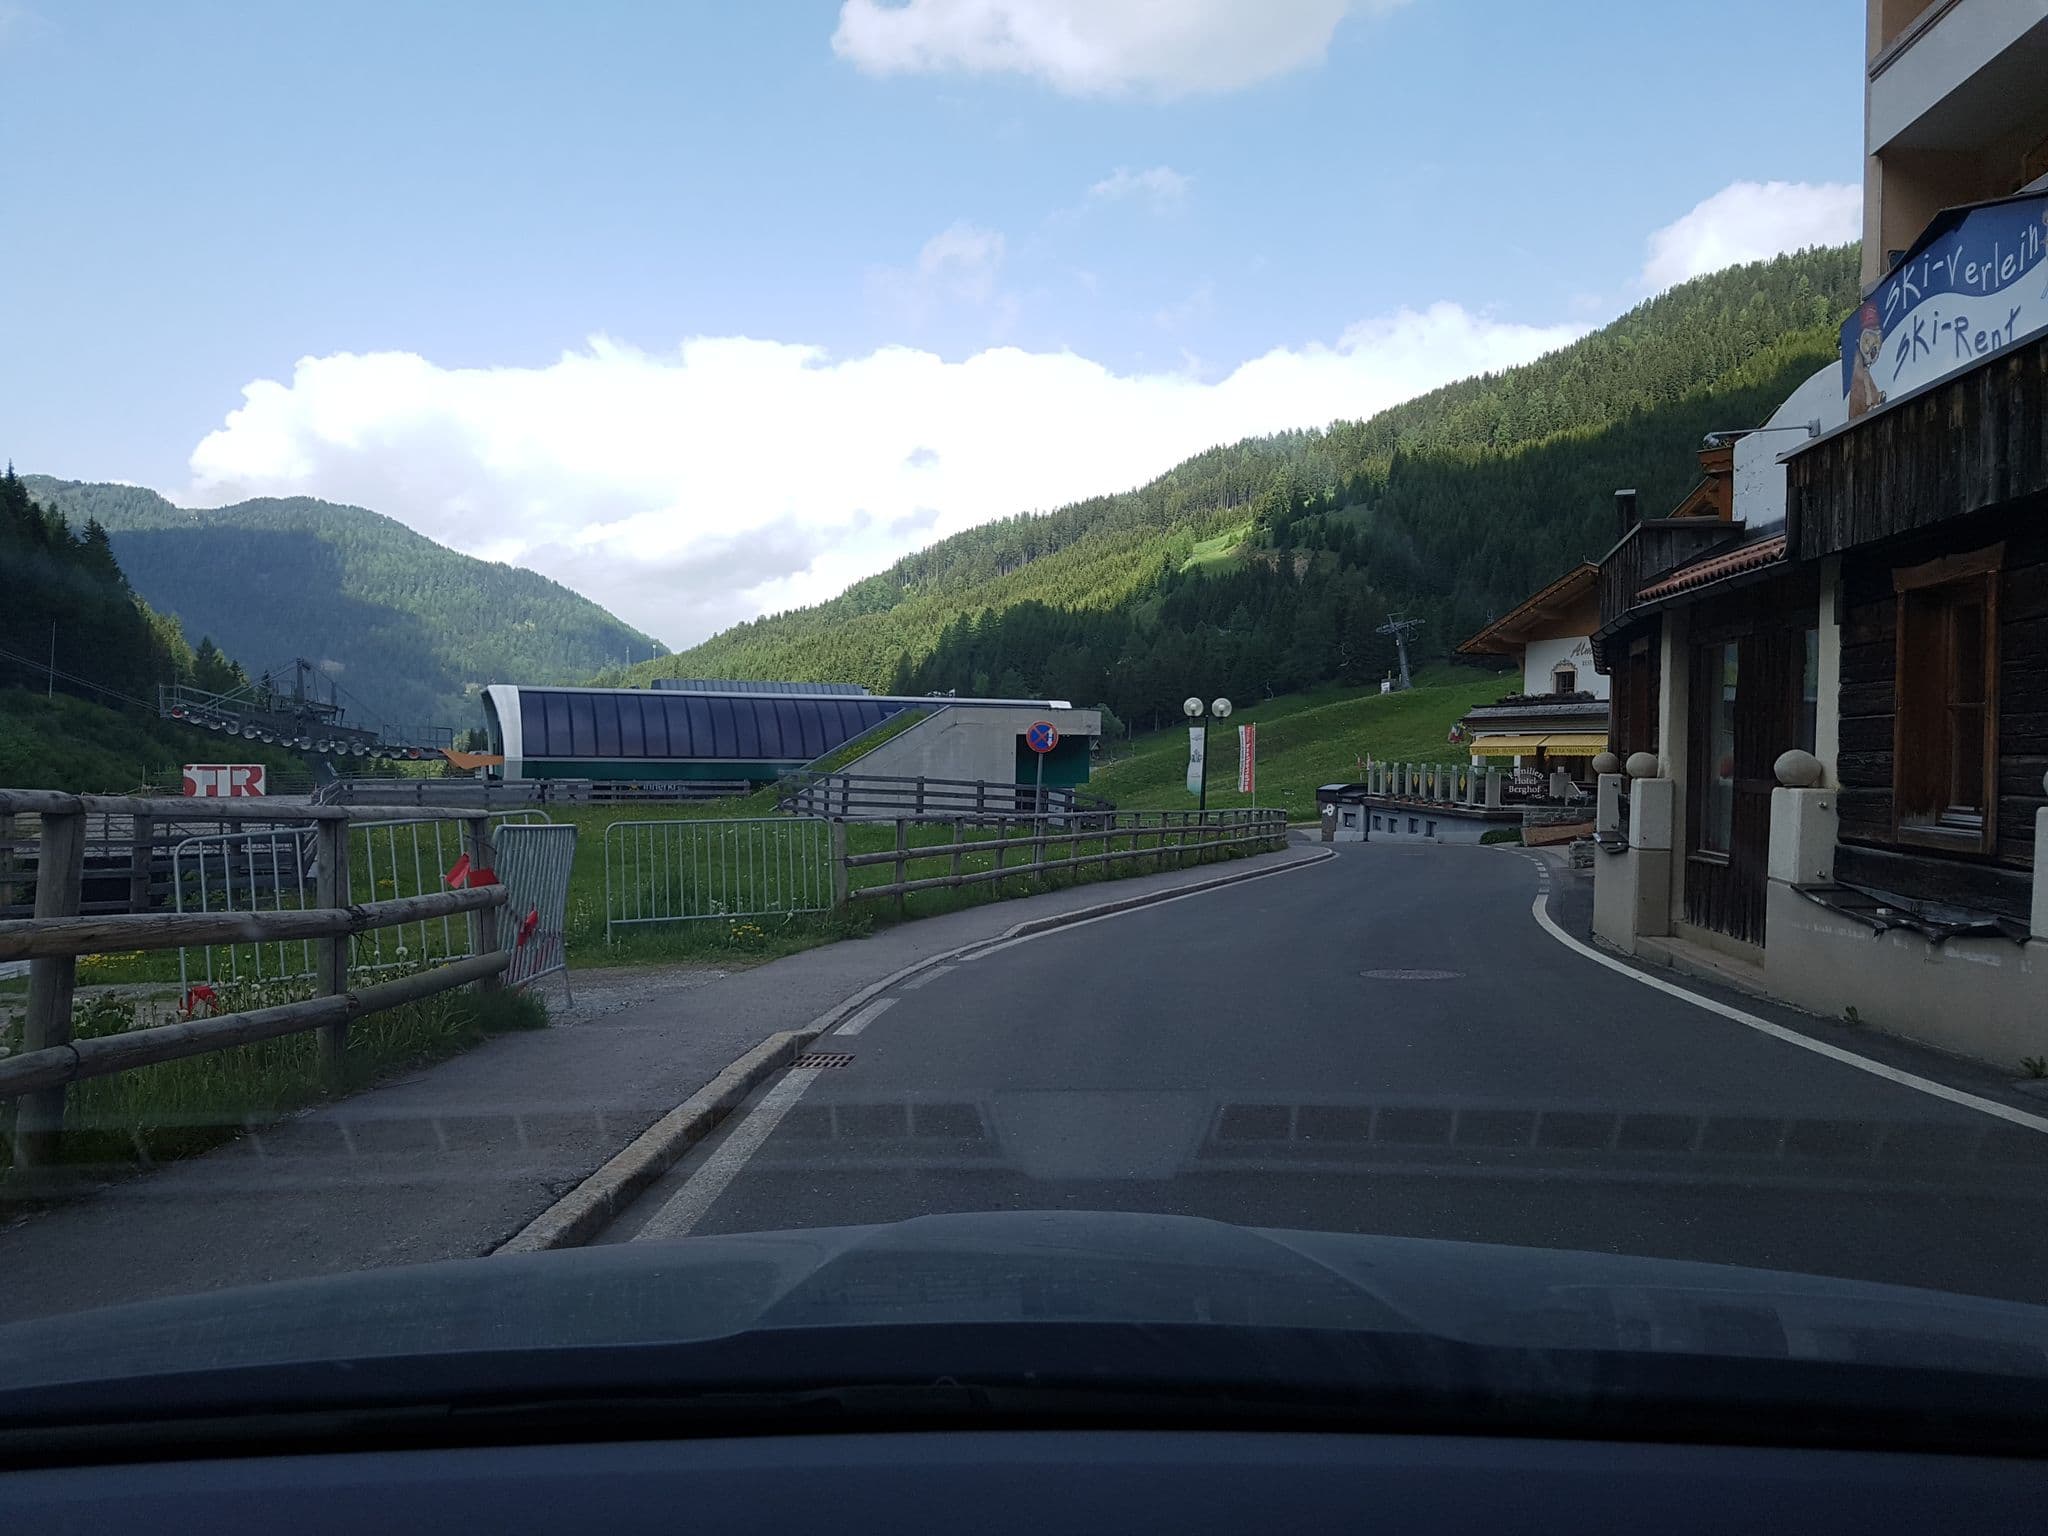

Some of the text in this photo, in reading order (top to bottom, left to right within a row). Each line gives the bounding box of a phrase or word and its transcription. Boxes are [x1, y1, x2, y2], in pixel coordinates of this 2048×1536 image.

[1507, 767, 1544, 780] Fmilien
[1514, 777, 1537, 785] Hotel
[1508, 785, 1542, 796] Berghof
